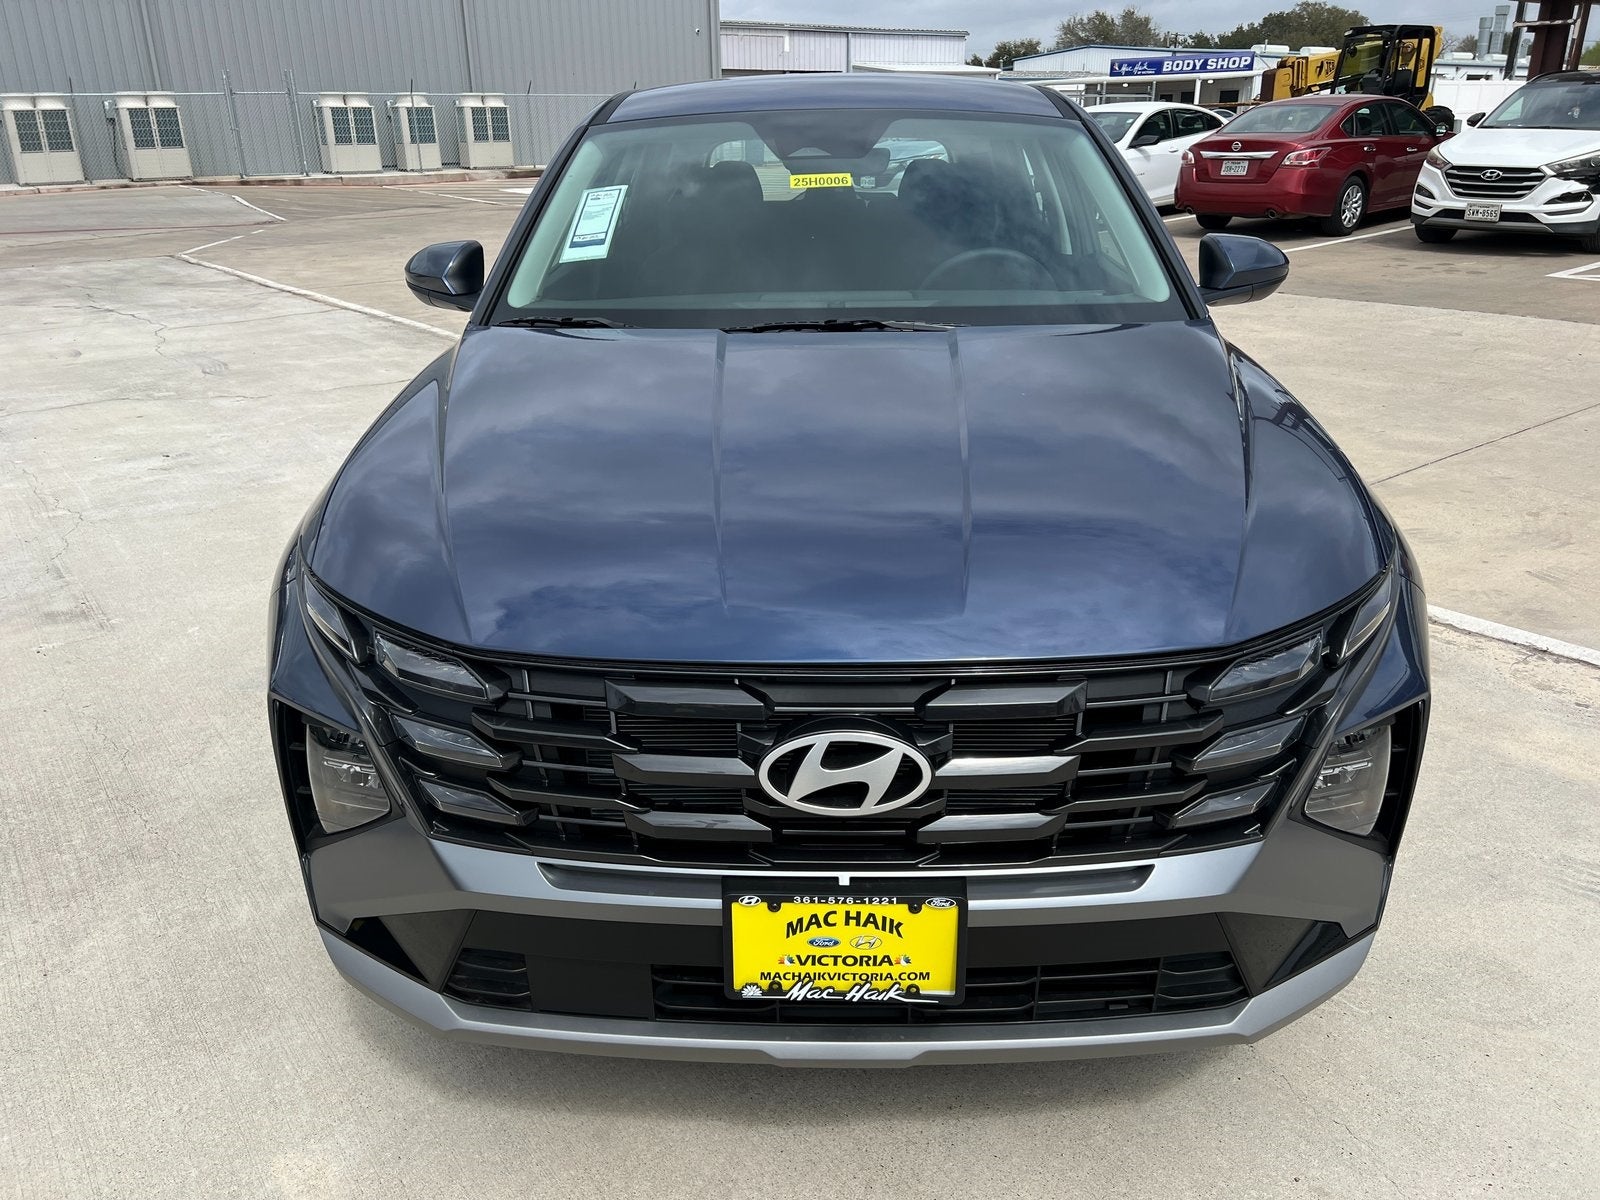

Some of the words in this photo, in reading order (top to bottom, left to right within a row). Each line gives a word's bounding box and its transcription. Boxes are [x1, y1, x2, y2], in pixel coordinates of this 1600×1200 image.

[1162, 58, 1204, 72] BODY
[1206, 56, 1251, 70] SHOP
[793, 176, 849, 187] 25H0006
[793, 895, 897, 905] 361-576-1221
[785, 910, 837, 939] MAC
[844, 910, 904, 939] HAIK
[795, 954, 894, 967] VICTORIA
[760, 971, 930, 981] MACHAIKVICTORIA.COM
[785, 980, 838, 1001] Mac
[844, 982, 908, 1002] Haik
